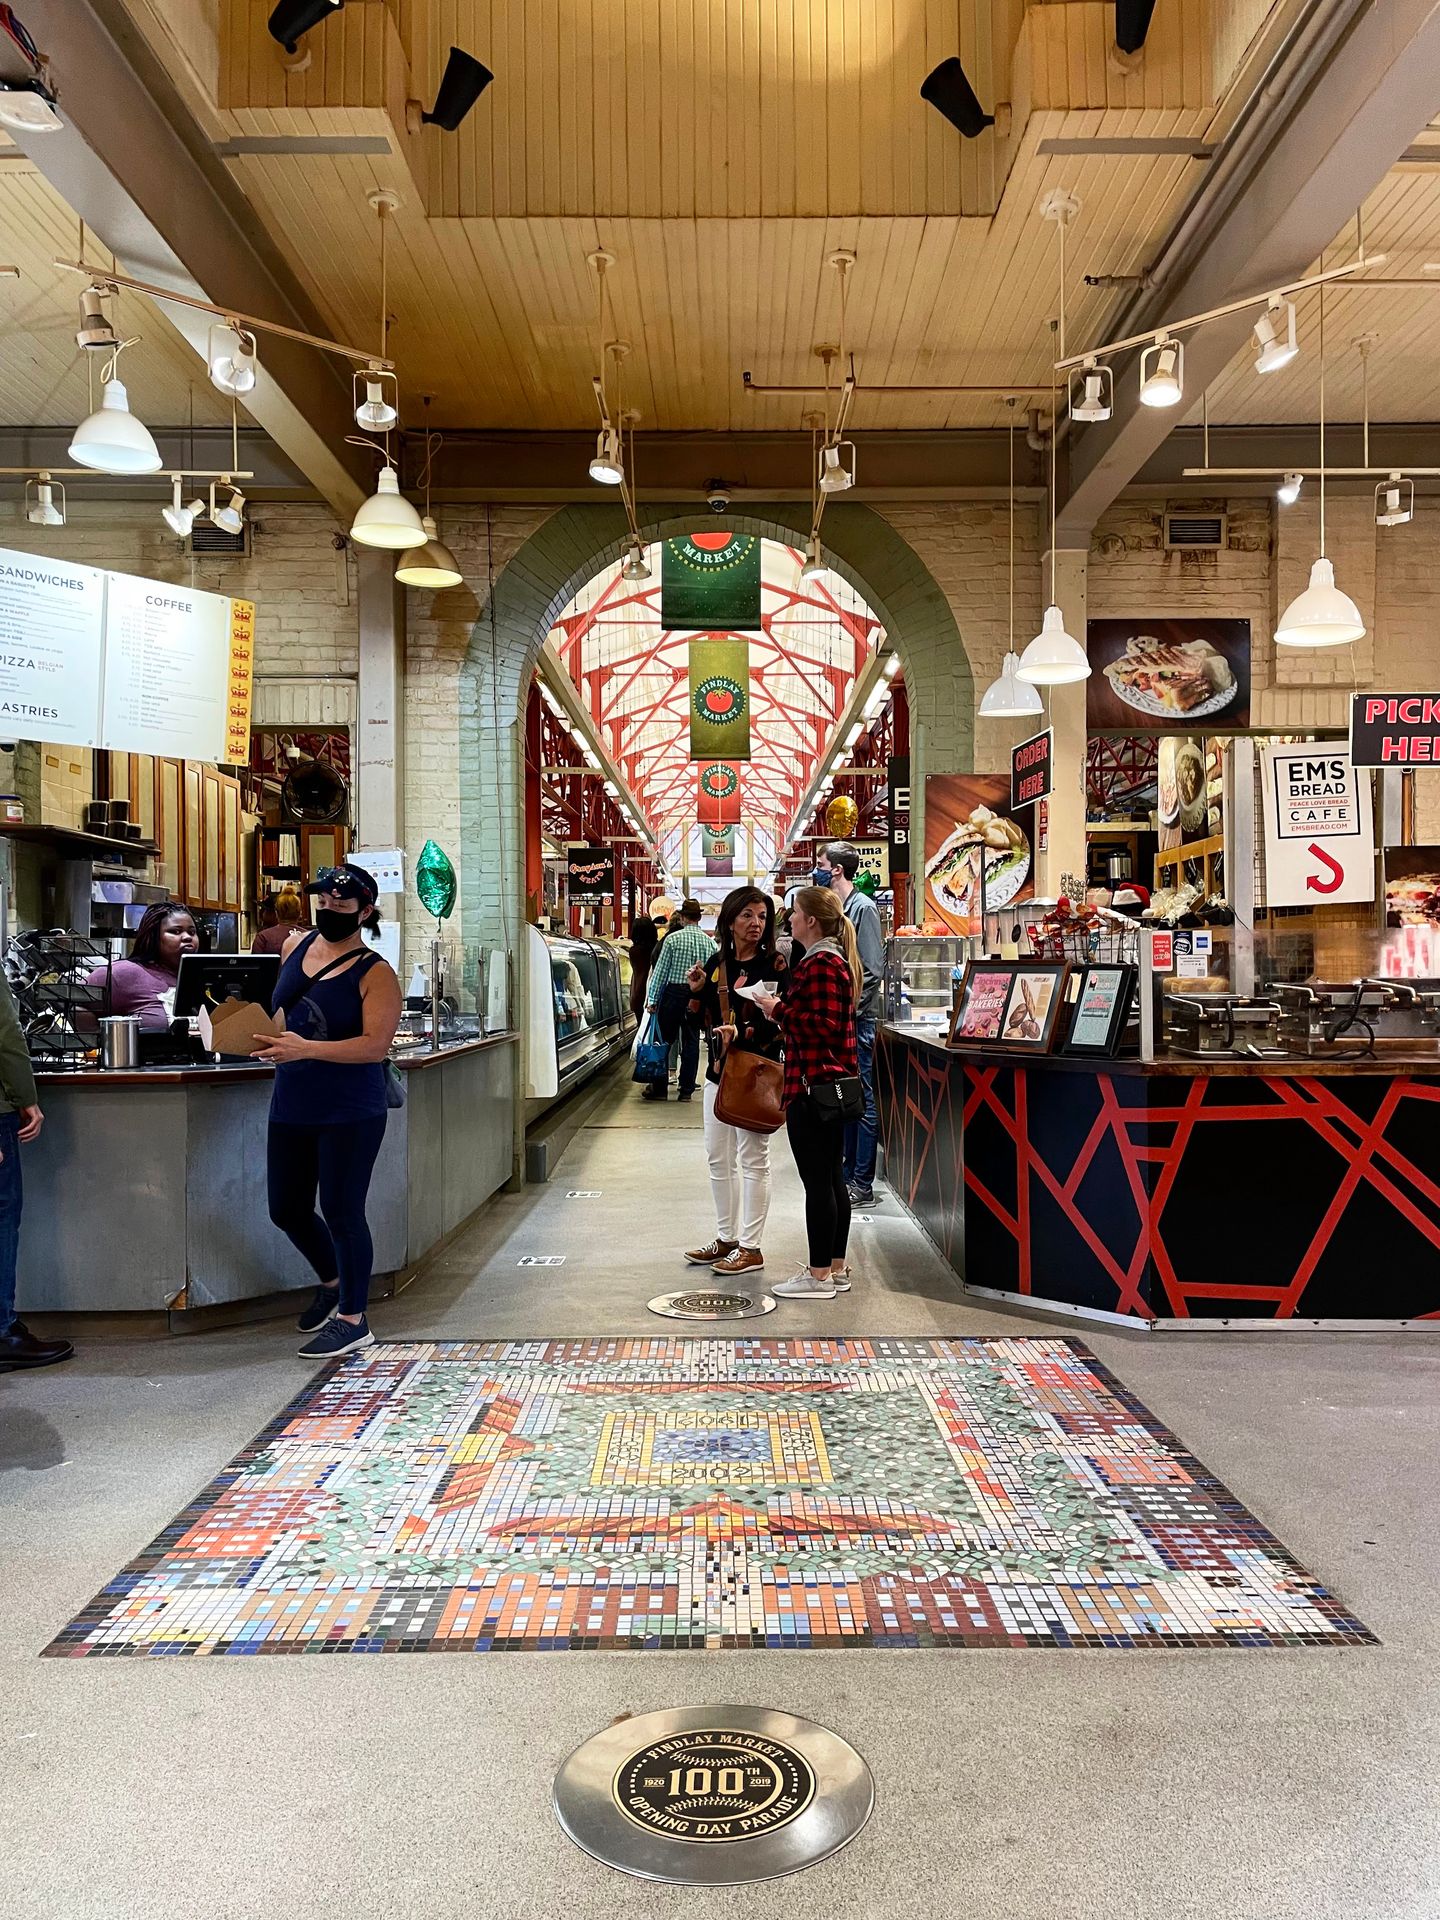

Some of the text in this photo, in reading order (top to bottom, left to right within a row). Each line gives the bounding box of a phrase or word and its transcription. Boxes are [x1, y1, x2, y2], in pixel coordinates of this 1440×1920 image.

[682, 540, 742, 564] MARKET
[0, 565, 84, 590] SANDWICHES
[146, 596, 192, 613] COFFEE
[700, 680, 739, 694] FINDLAY
[702, 708, 738, 720] MARKET
[1365, 698, 1440, 723] PICK
[1016, 738, 1048, 772] ORDER
[1289, 760, 1345, 782] EM'S
[1019, 771, 1044, 801] HERE
[1290, 782, 1346, 796] BREAD
[1290, 809, 1346, 821] CAFE
[714, 845, 725, 854] EXIT
[569, 858, 613, 874] Grayson's
[968, 1000, 1003, 1009] BAKERIES
[674, 1467, 751, 1479] 2002
[646, 1734, 785, 1760] FINDLAY MARKET
[644, 1778, 665, 1786] 1920
[628, 1795, 799, 1835] OPENING DAY PARADE
